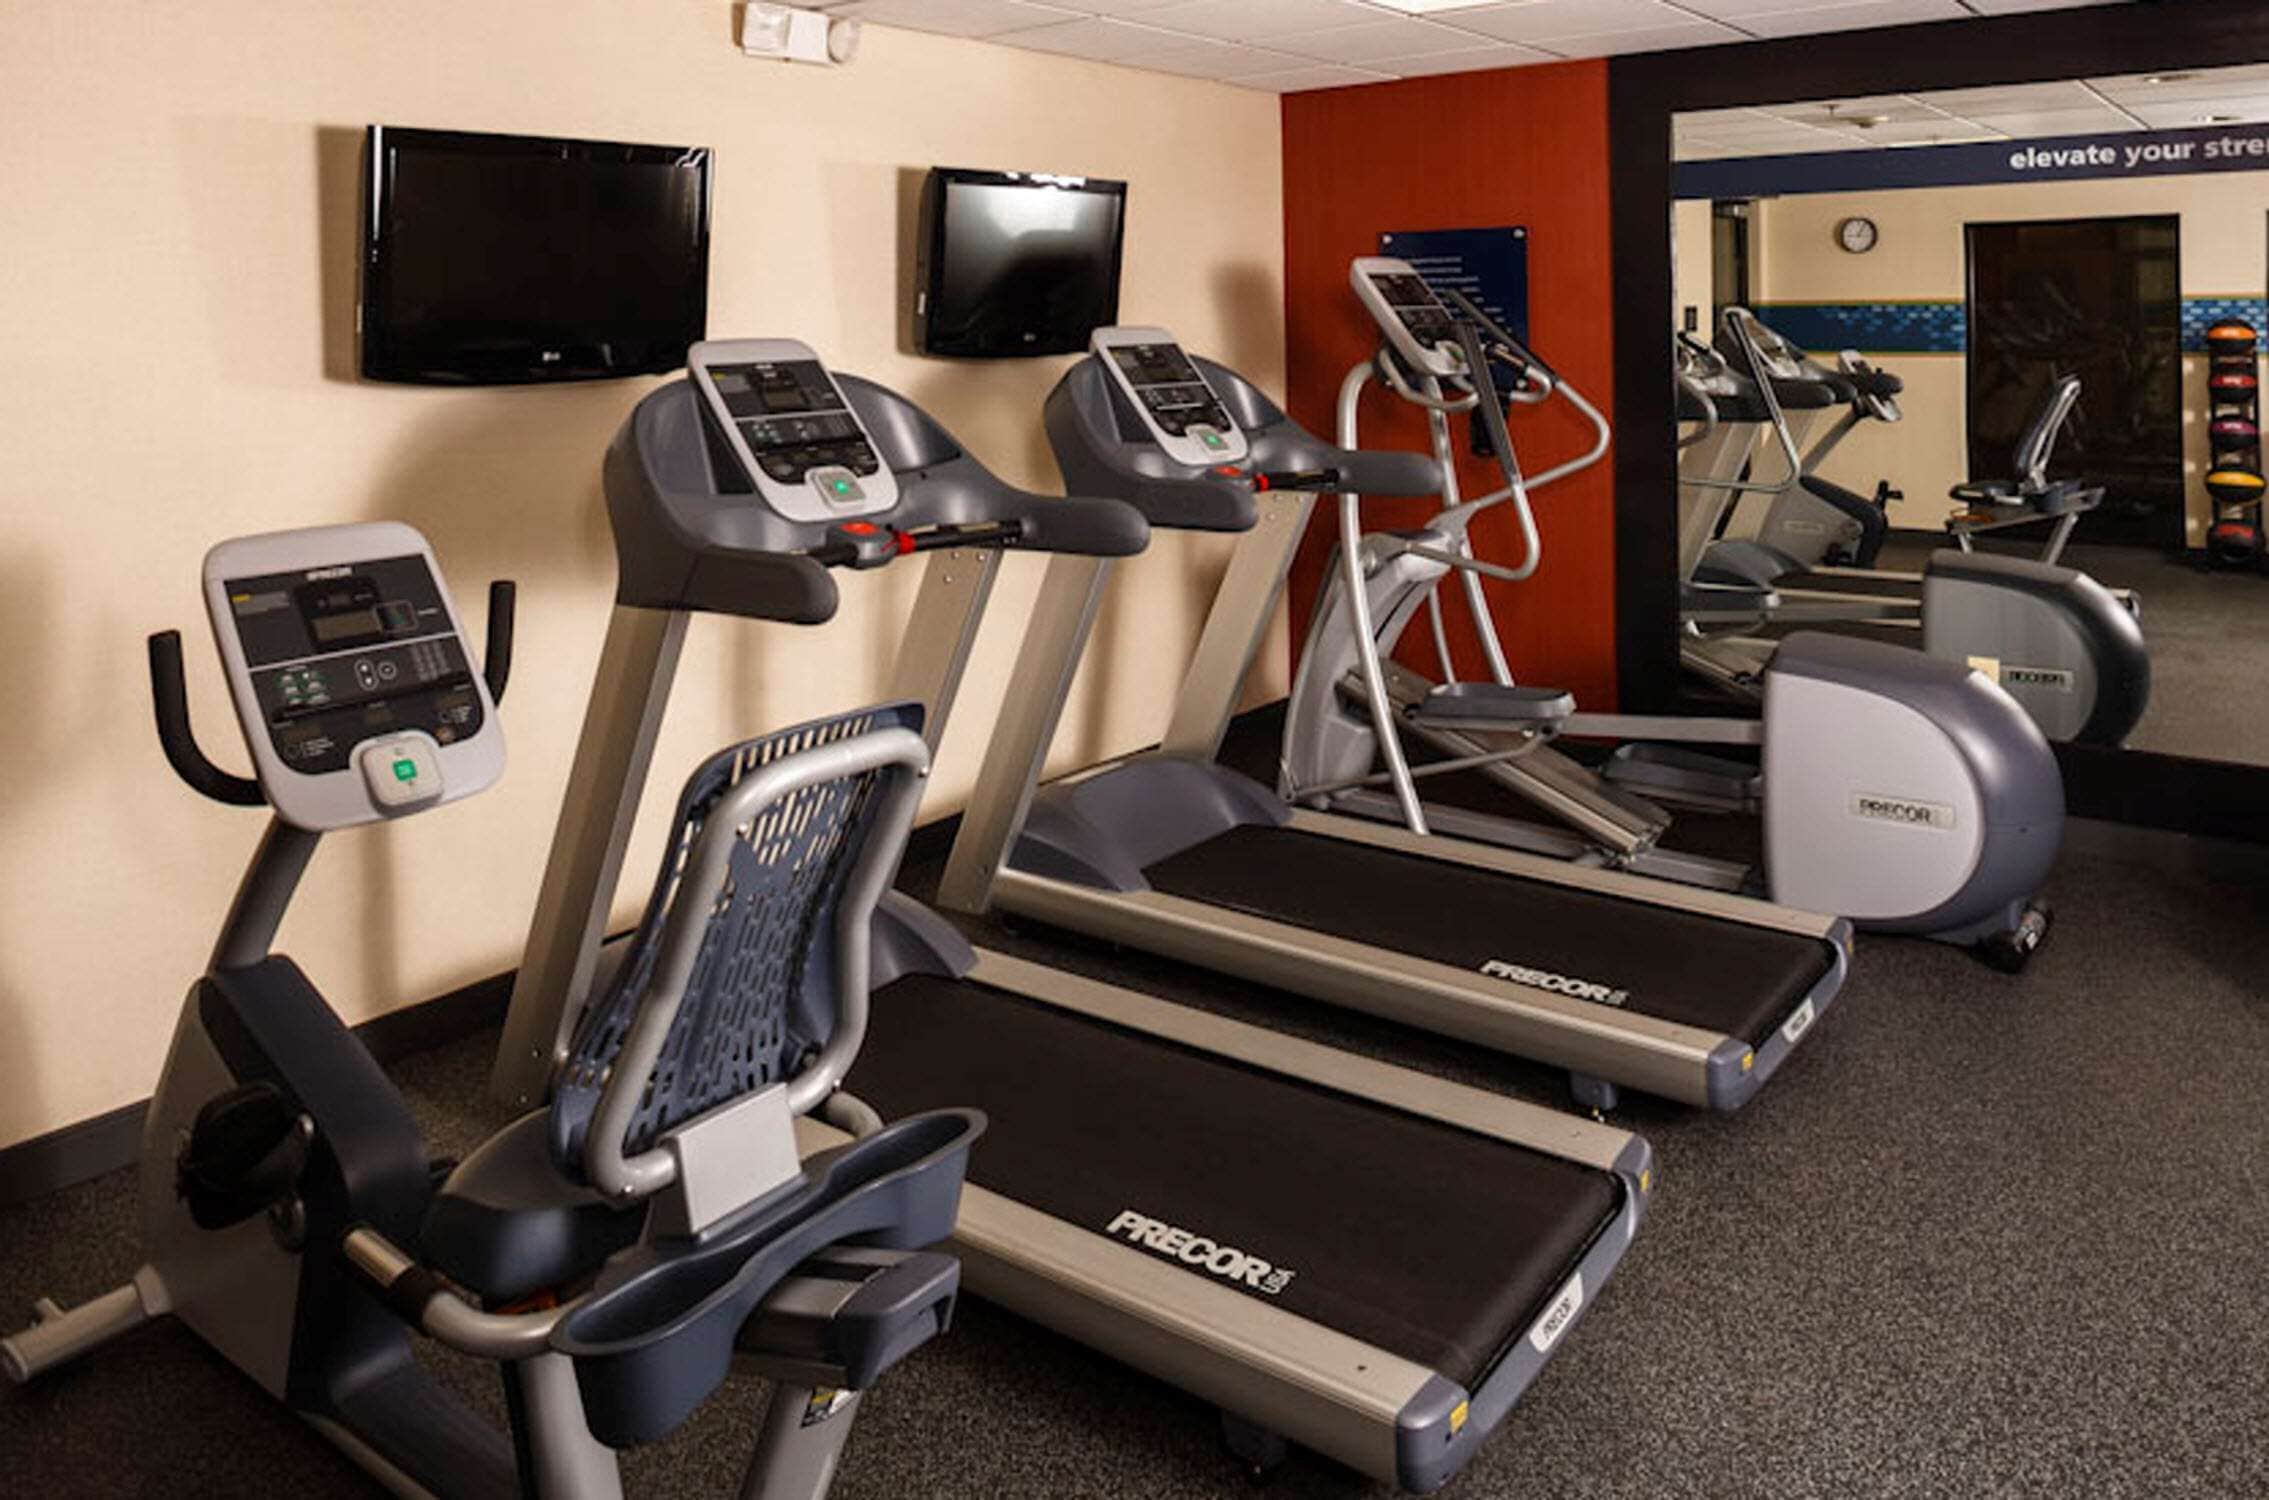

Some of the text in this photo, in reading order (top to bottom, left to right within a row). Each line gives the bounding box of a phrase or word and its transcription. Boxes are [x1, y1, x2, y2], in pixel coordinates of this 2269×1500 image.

[2010, 136, 2269, 169] elevate your stre
[1480, 959, 1612, 1003] PRECOR
[1106, 1210, 1272, 1286] PRECOR
